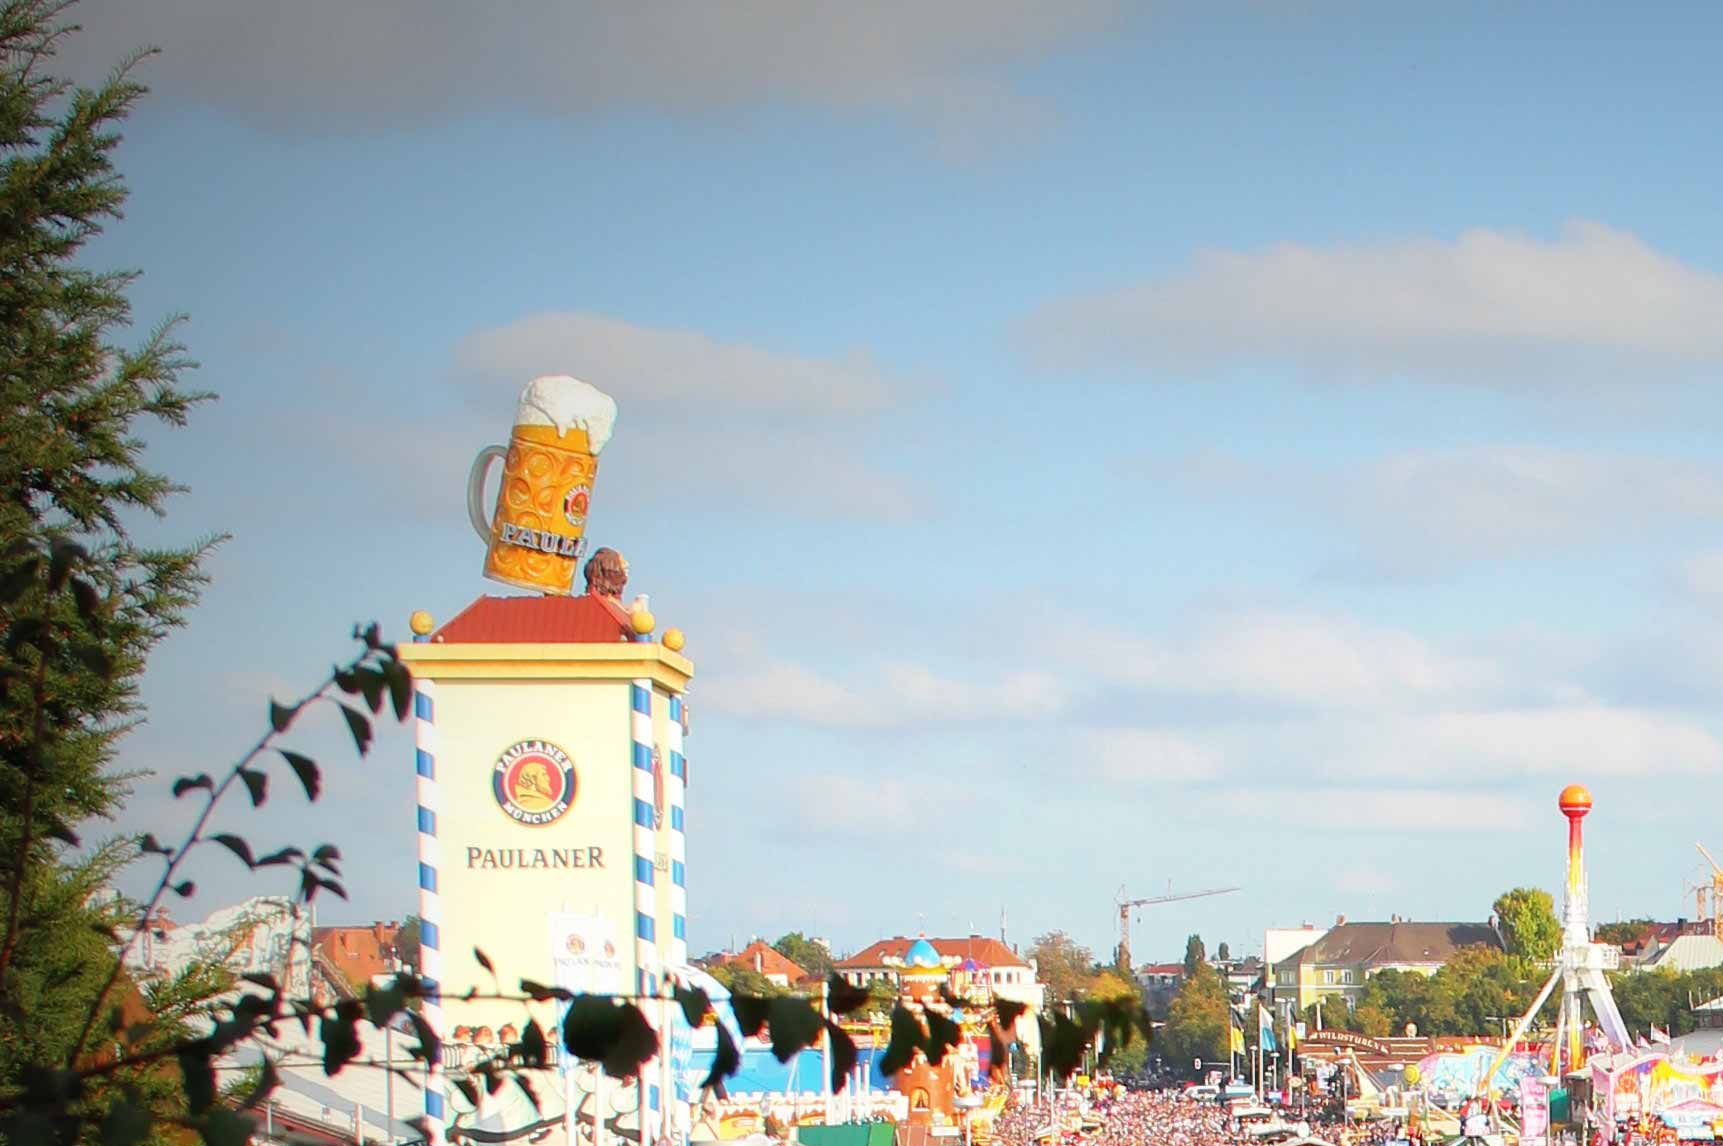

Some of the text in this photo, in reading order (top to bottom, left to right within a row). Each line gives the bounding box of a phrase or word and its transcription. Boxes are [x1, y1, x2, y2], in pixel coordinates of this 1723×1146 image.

[496, 740, 573, 773] PAULANER
[465, 846, 606, 870] PAULANER
[1319, 1031, 1379, 1049] WILDSTUBEN
